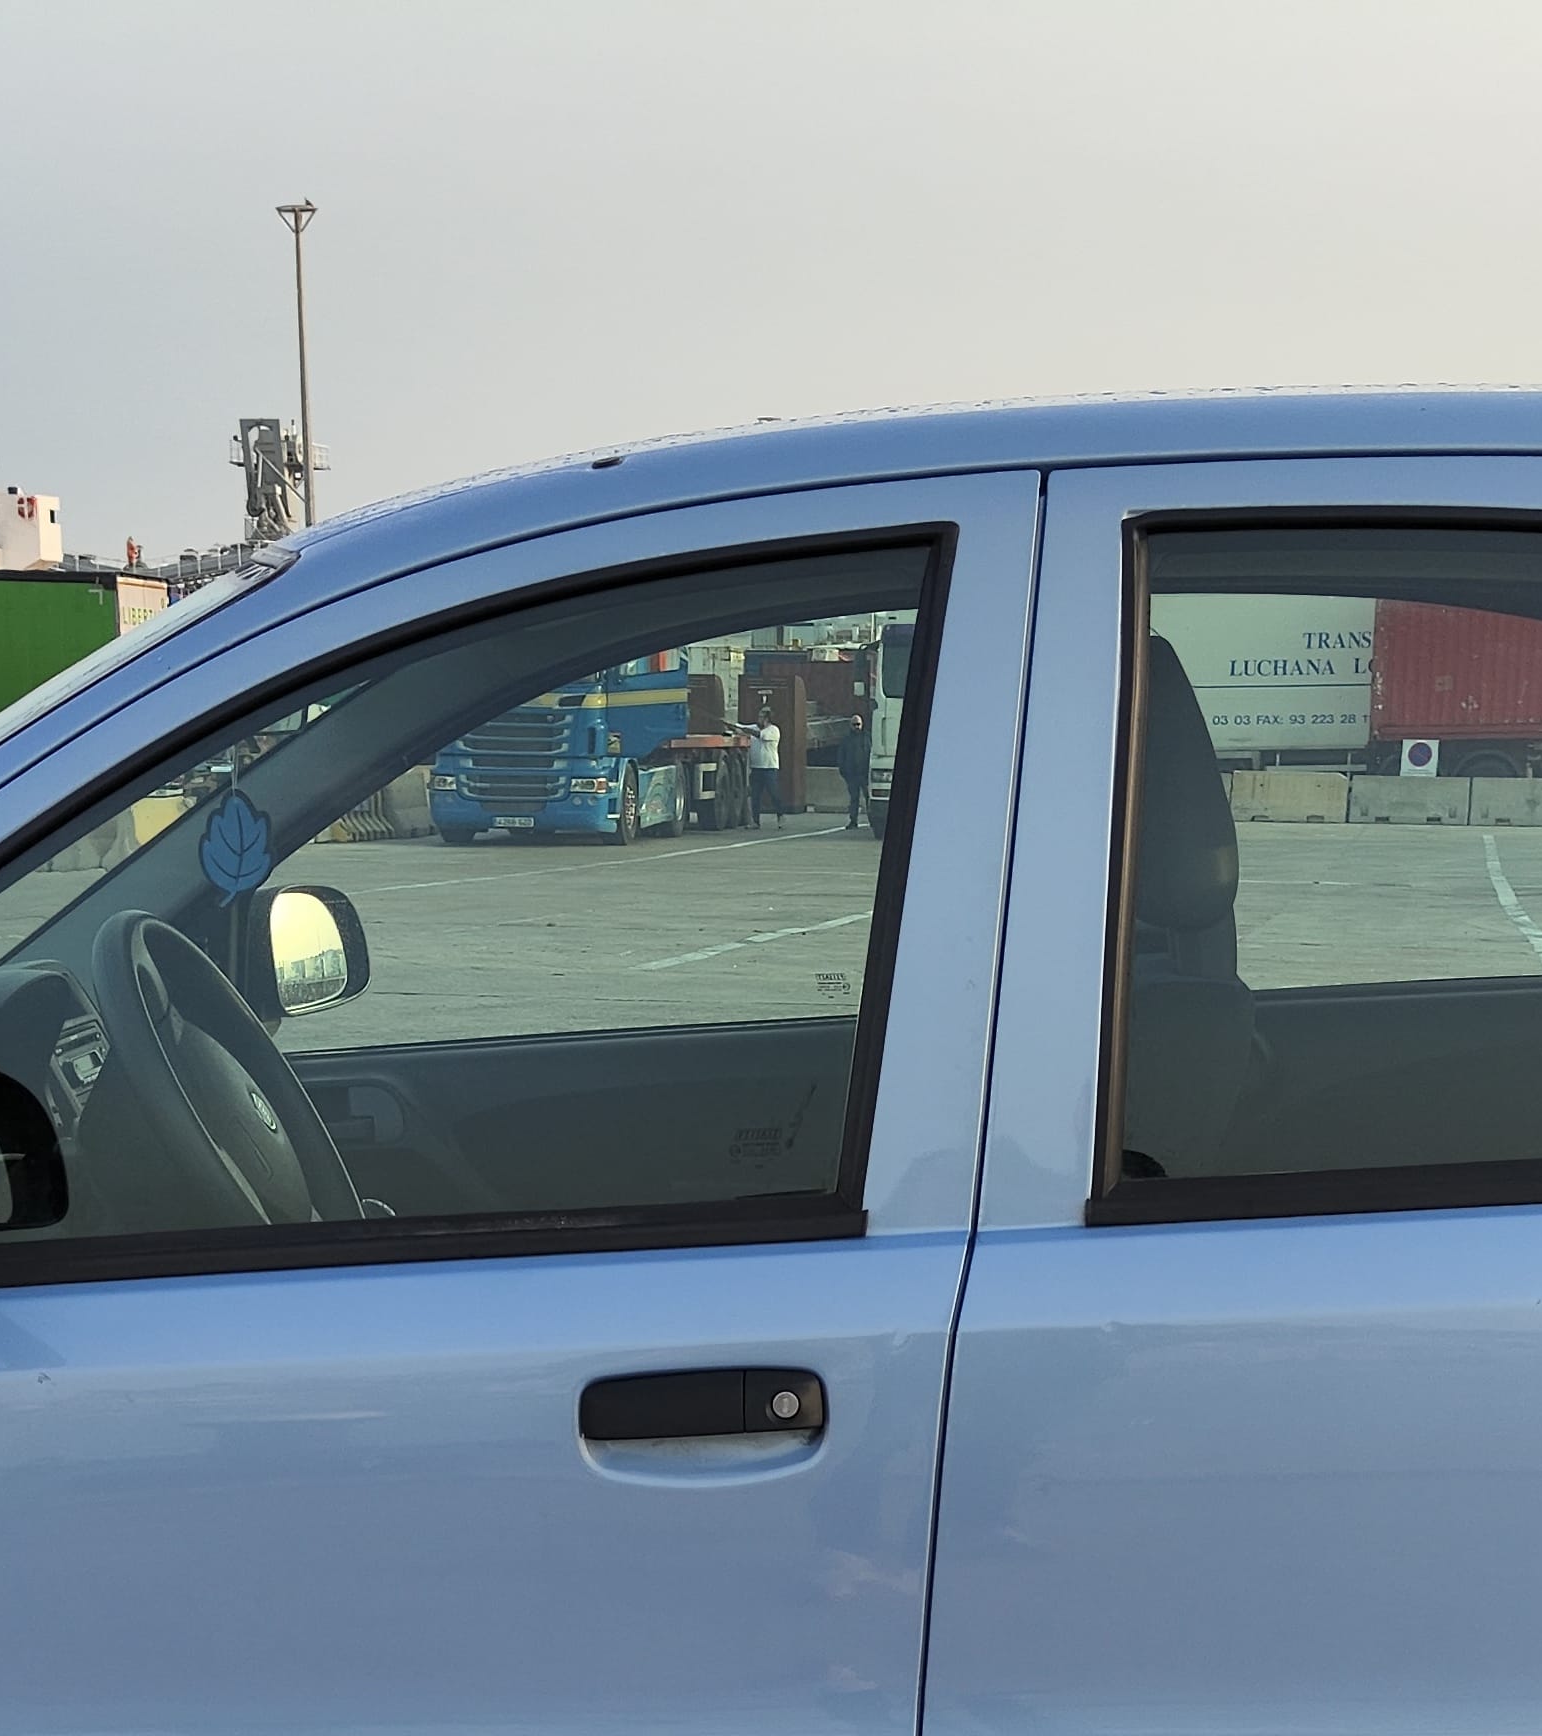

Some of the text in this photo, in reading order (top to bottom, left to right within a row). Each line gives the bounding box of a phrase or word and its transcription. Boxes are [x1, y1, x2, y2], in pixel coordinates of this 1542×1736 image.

[1302, 630, 1372, 650] TRANS
[1229, 657, 1336, 677] LUCHANA
[1211, 714, 1229, 726] 03
[1233, 714, 1251, 726] 03
[1256, 714, 1284, 726] FAX:
[1288, 713, 1306, 725] 93
[1311, 713, 1335, 725] 223
[1340, 712, 1357, 724] 28
